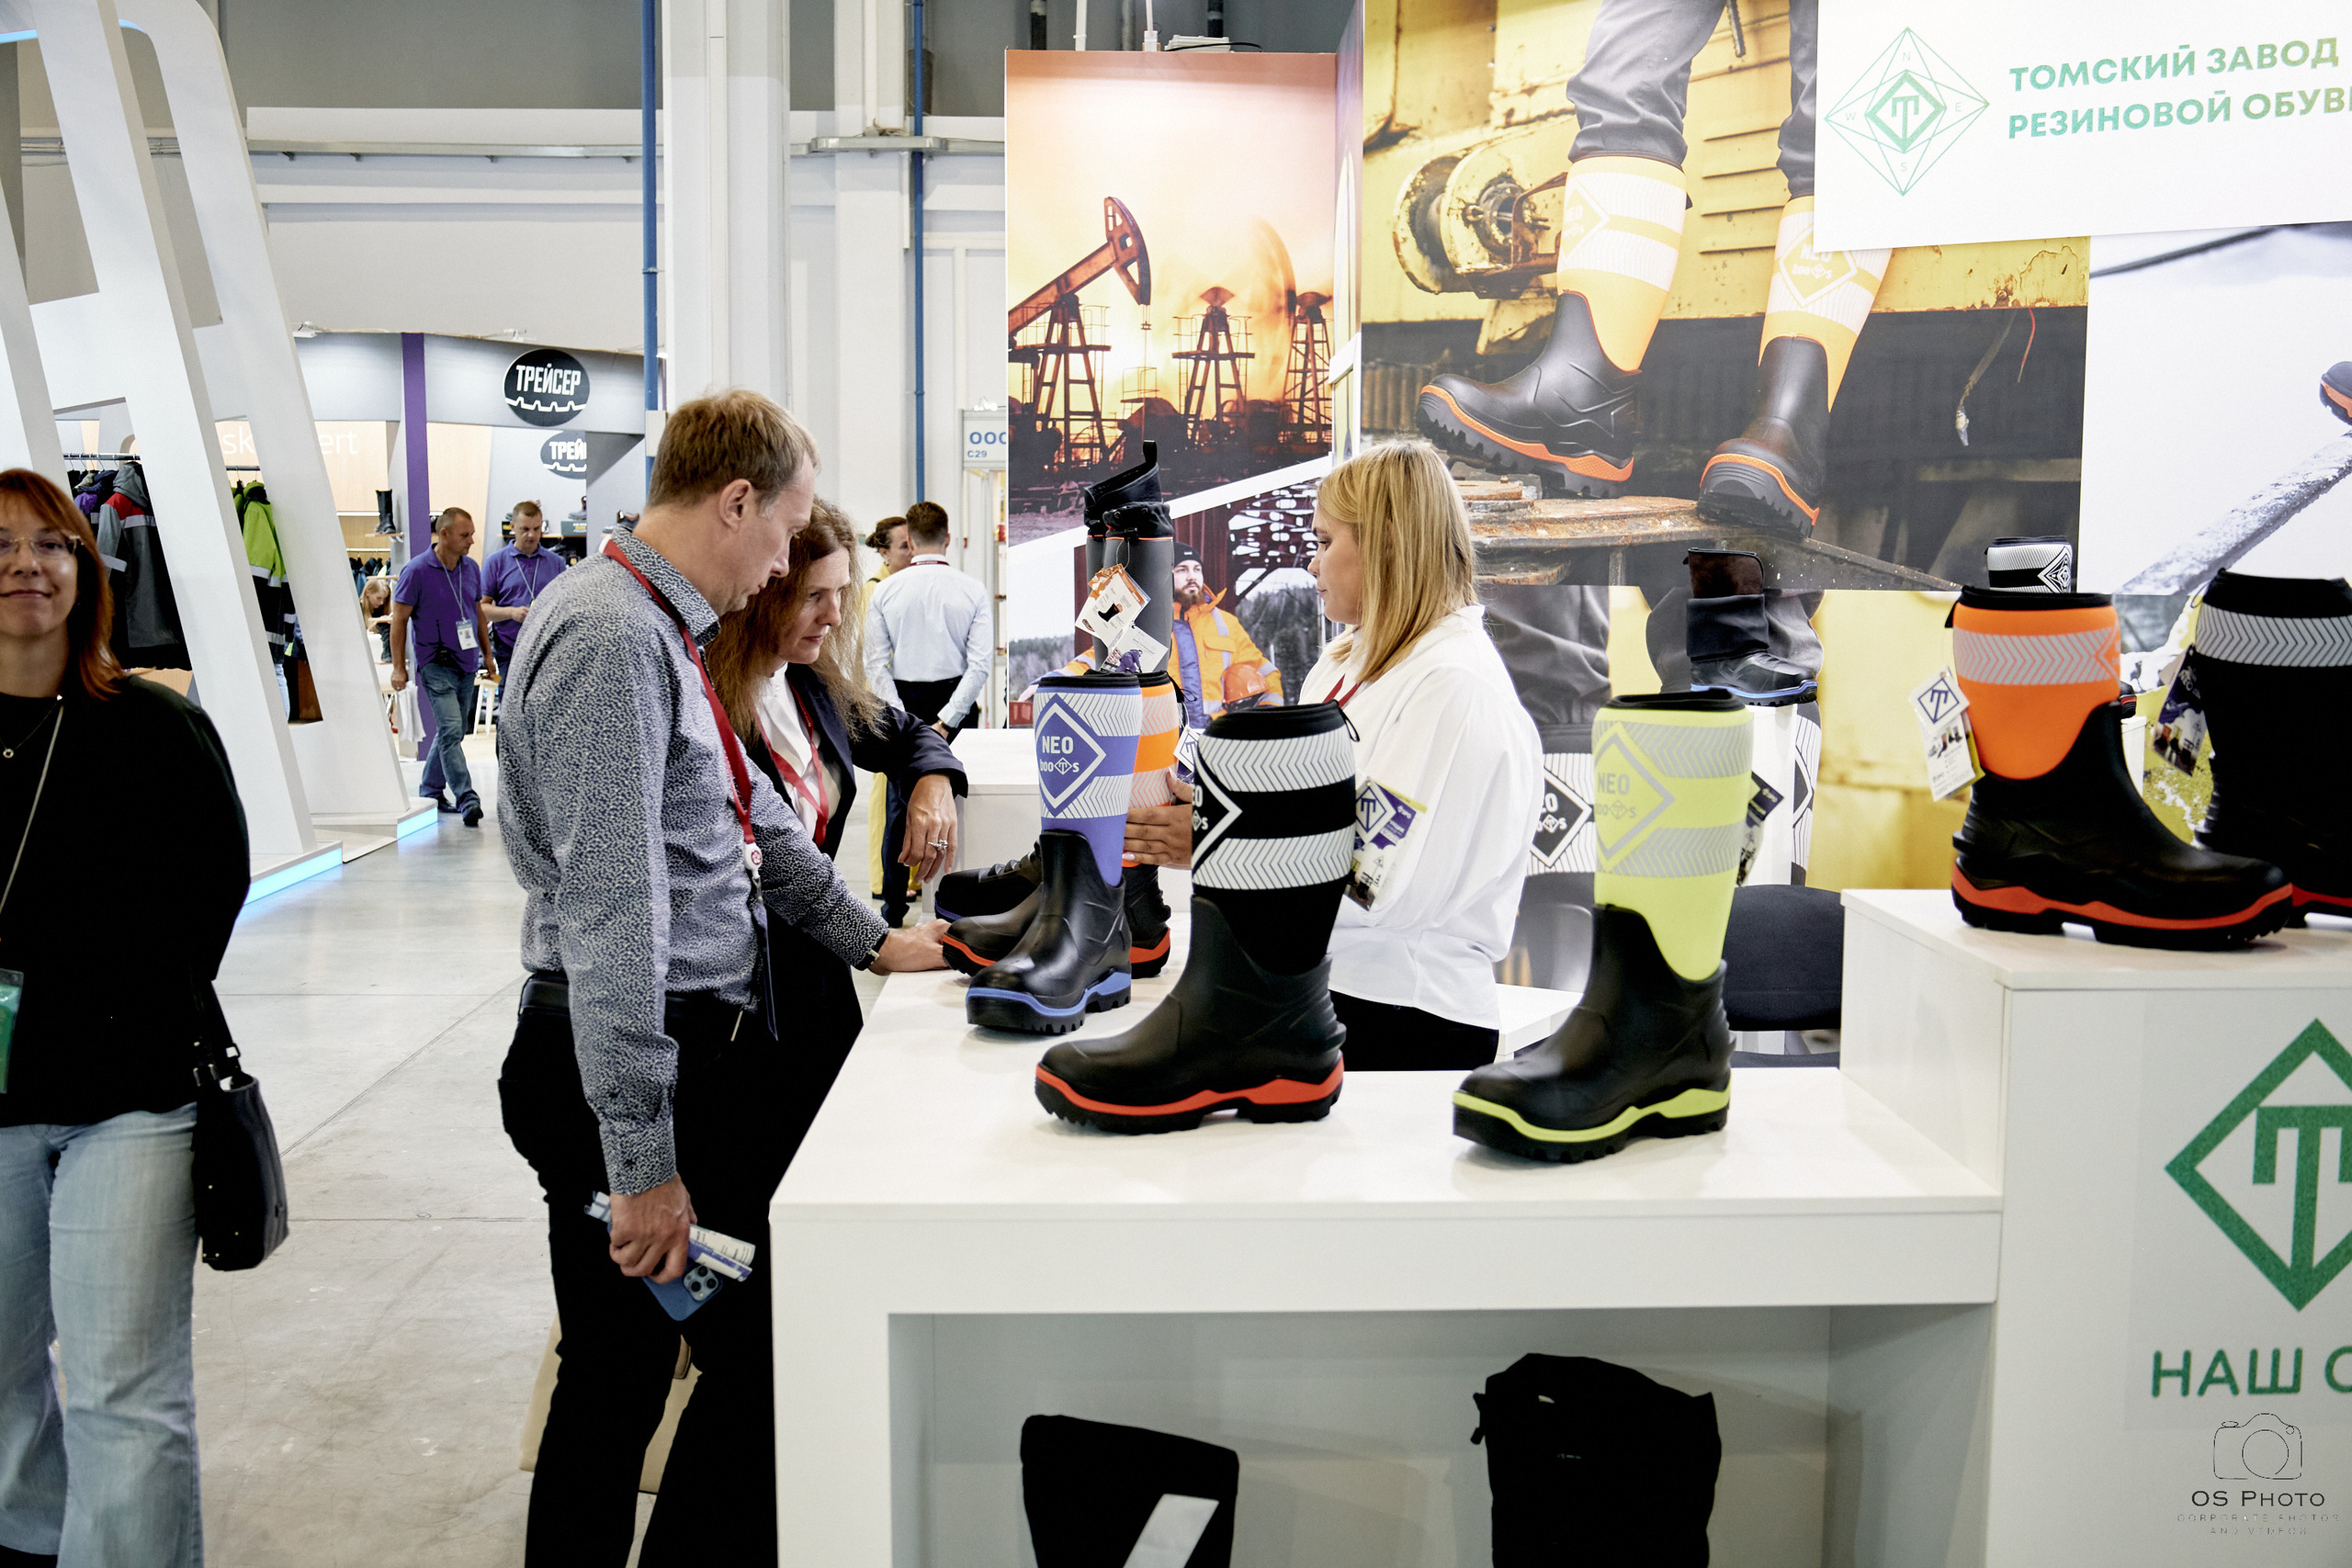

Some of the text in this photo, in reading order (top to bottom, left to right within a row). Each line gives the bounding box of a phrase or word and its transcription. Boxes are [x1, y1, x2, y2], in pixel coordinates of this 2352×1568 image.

[1902, 51, 1911, 62] N
[2008, 37, 2339, 92] ТОМСКИЙ ЗАВОД
[2008, 86, 2352, 139] РЕЗИНОВОЙ ОБУВ
[515, 363, 582, 396] ТРЕЙСЕР
[548, 438, 586, 460] ТРЕЙ
[1042, 735, 1074, 754] NEO
[1598, 773, 1631, 795] NEO
[2151, 1347, 2303, 1398] НАШ
